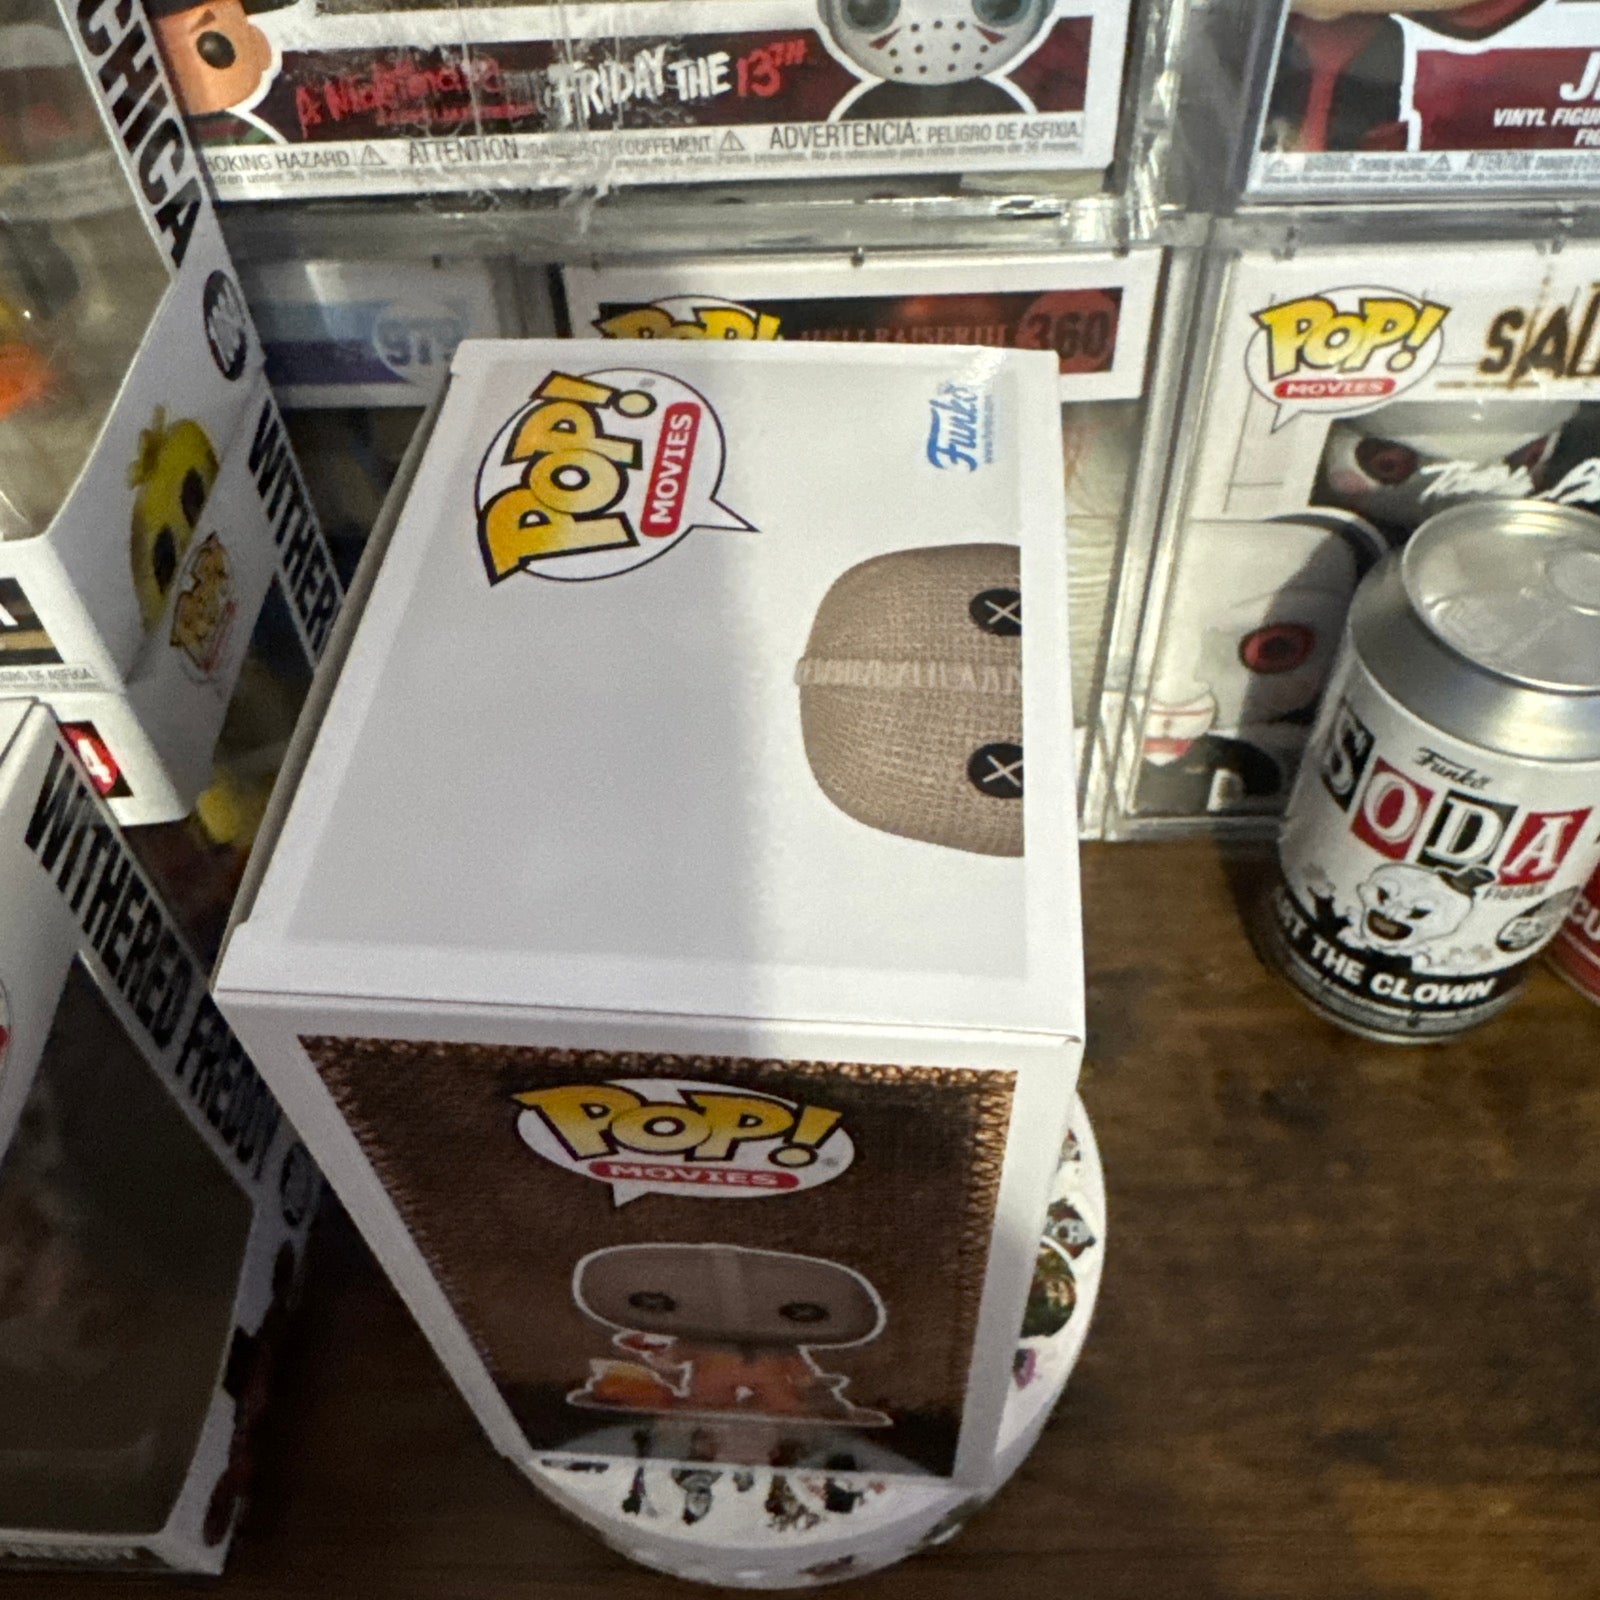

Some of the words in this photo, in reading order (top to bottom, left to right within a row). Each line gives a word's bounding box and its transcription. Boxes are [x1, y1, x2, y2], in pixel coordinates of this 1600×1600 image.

[545, 43, 668, 127] FRIDAY
[668, 51, 733, 101] THE
[1560, 52, 1600, 100] J
[77, 0, 202, 269] CHICA
[409, 138, 519, 166] ATTENTION
[770, 121, 921, 150] ADVERTENCIA:
[929, 124, 991, 145] PELIGRO
[996, 123, 1018, 141] DE
[1494, 108, 1547, 127] VINYL
[276, 150, 349, 169] HAZARD
[1027, 311, 1109, 358] 360
[1250, 293, 1451, 382] POP!
[926, 383, 979, 472] Funko
[1286, 382, 1386, 397] MOVIES
[477, 369, 657, 588] POP!
[650, 413, 693, 525] MOVIES
[248, 398, 345, 655] WITHER
[1324, 703, 1575, 877] SODA
[1414, 746, 1494, 790] Funko
[25, 742, 194, 1050] WITHERED
[1310, 934, 1366, 985] THE
[1370, 973, 1498, 1005] CLOWN
[511, 1084, 843, 1168] POP!
[611, 1165, 779, 1187] MOVIES
